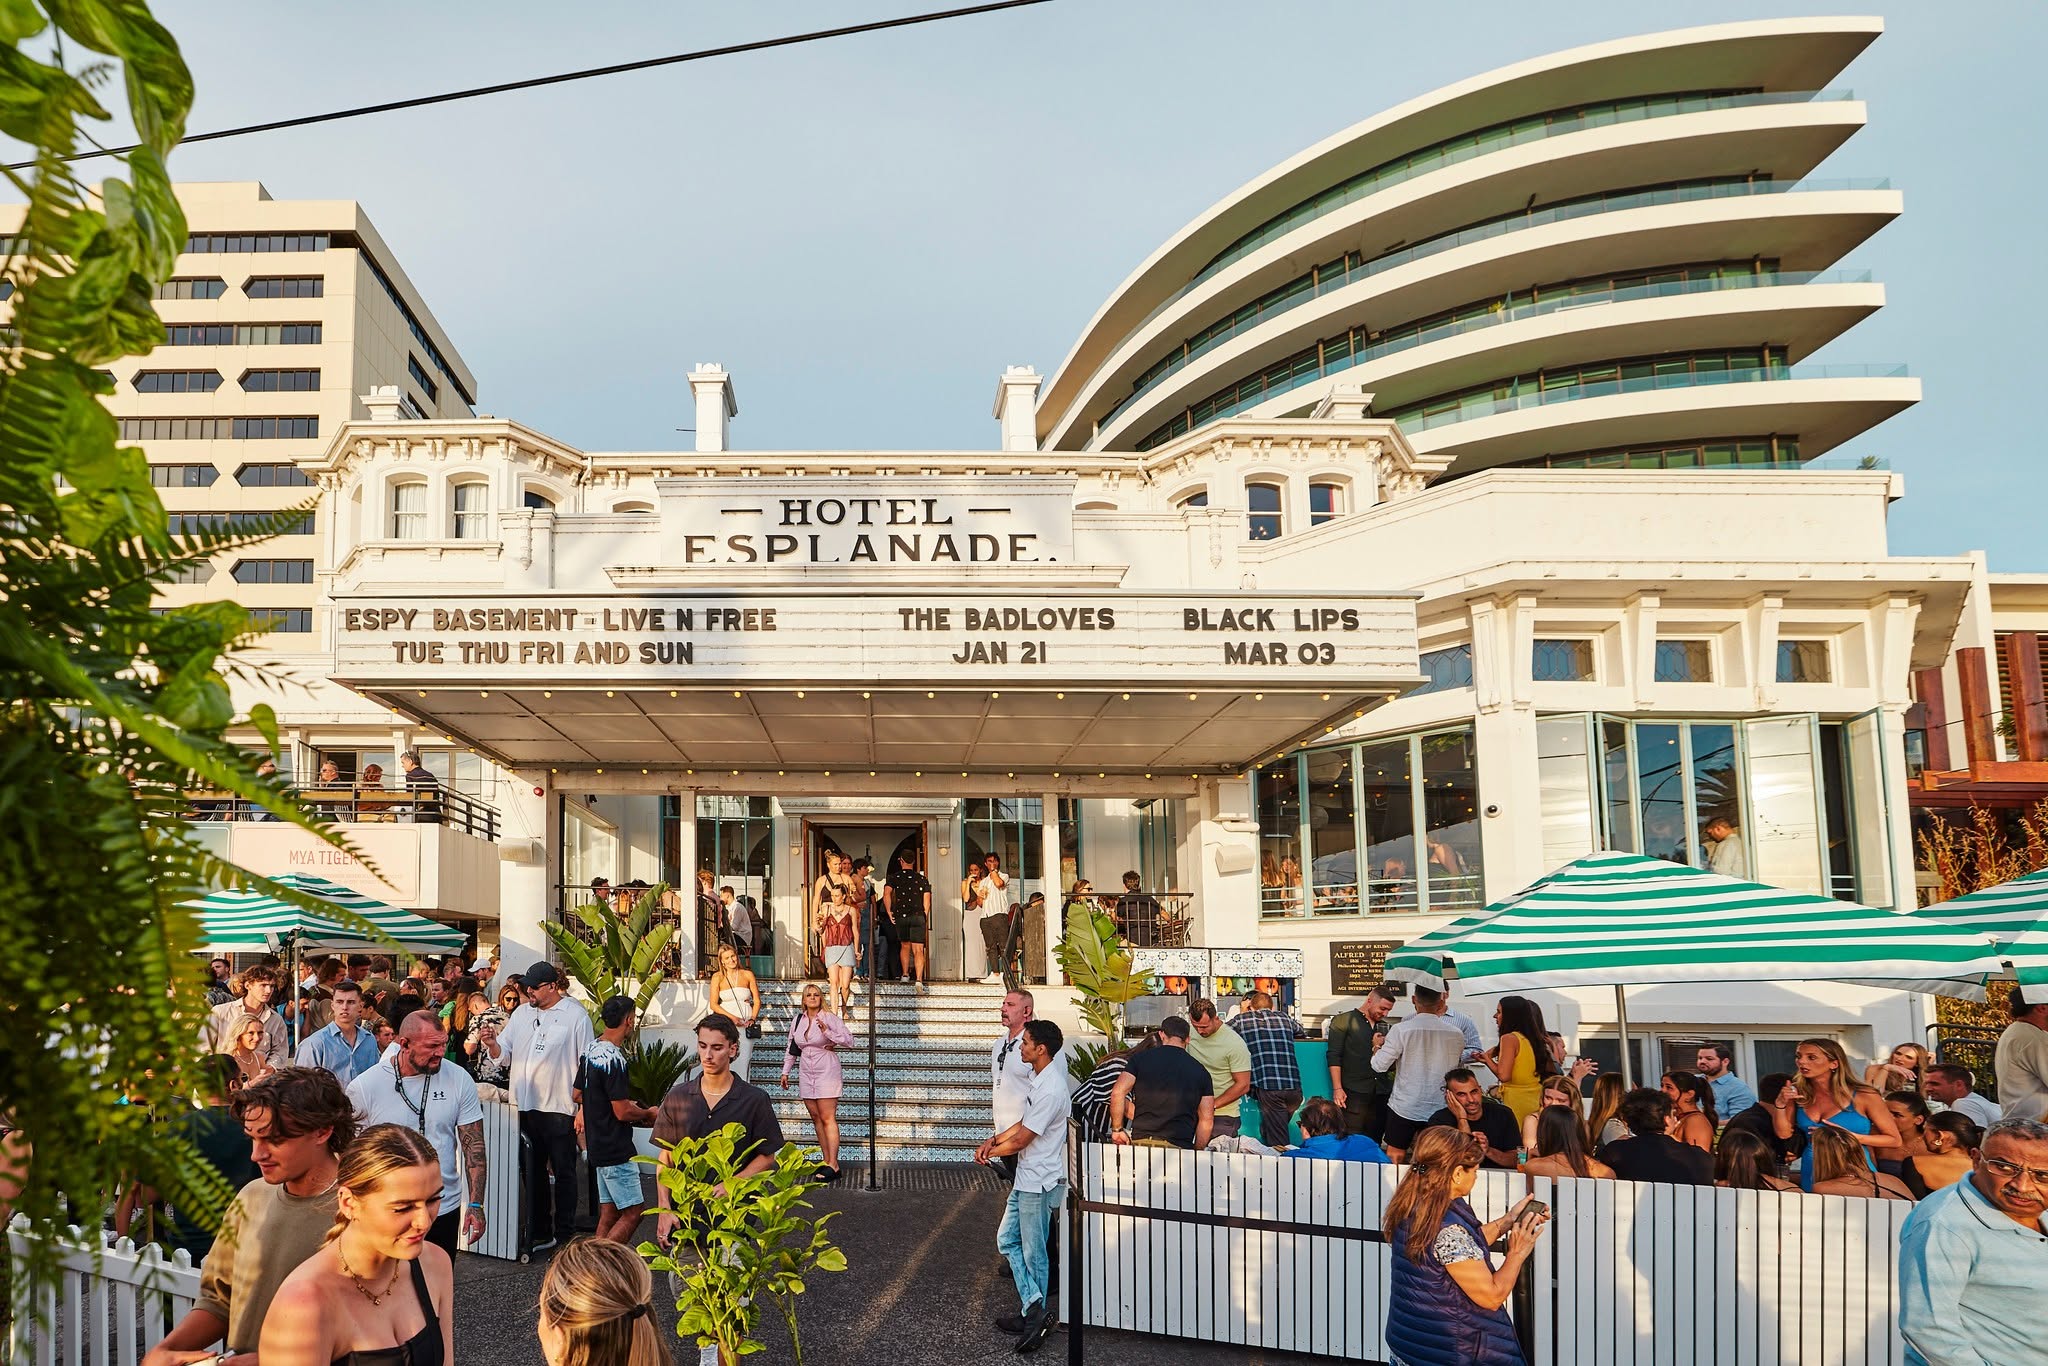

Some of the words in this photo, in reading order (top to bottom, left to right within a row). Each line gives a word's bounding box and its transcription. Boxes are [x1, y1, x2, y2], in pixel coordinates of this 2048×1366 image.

[779, 499, 952, 525] HOTEL
[345, 608, 418, 631] ESPY
[433, 608, 577, 631] BASEMENT
[603, 608, 665, 631] LIVE
[676, 608, 693, 631] N
[706, 608, 777, 631] FREE
[898, 607, 950, 631] THE
[965, 607, 1115, 631] BADLOVES
[1183, 608, 1275, 631] BLACK
[1293, 608, 1360, 631] LIPS
[392, 641, 445, 664] TUE
[458, 641, 509, 664] THU
[519, 641, 564, 664] FRI
[573, 641, 631, 664] AND
[638, 641, 693, 664] SUN
[952, 641, 1008, 664] JAN
[1020, 641, 1046, 664] 21
[1224, 642, 1288, 665] MAR
[1297, 642, 1336, 665] 03
[289, 851, 315, 865] MYA
[319, 851, 358, 865] TIGER
